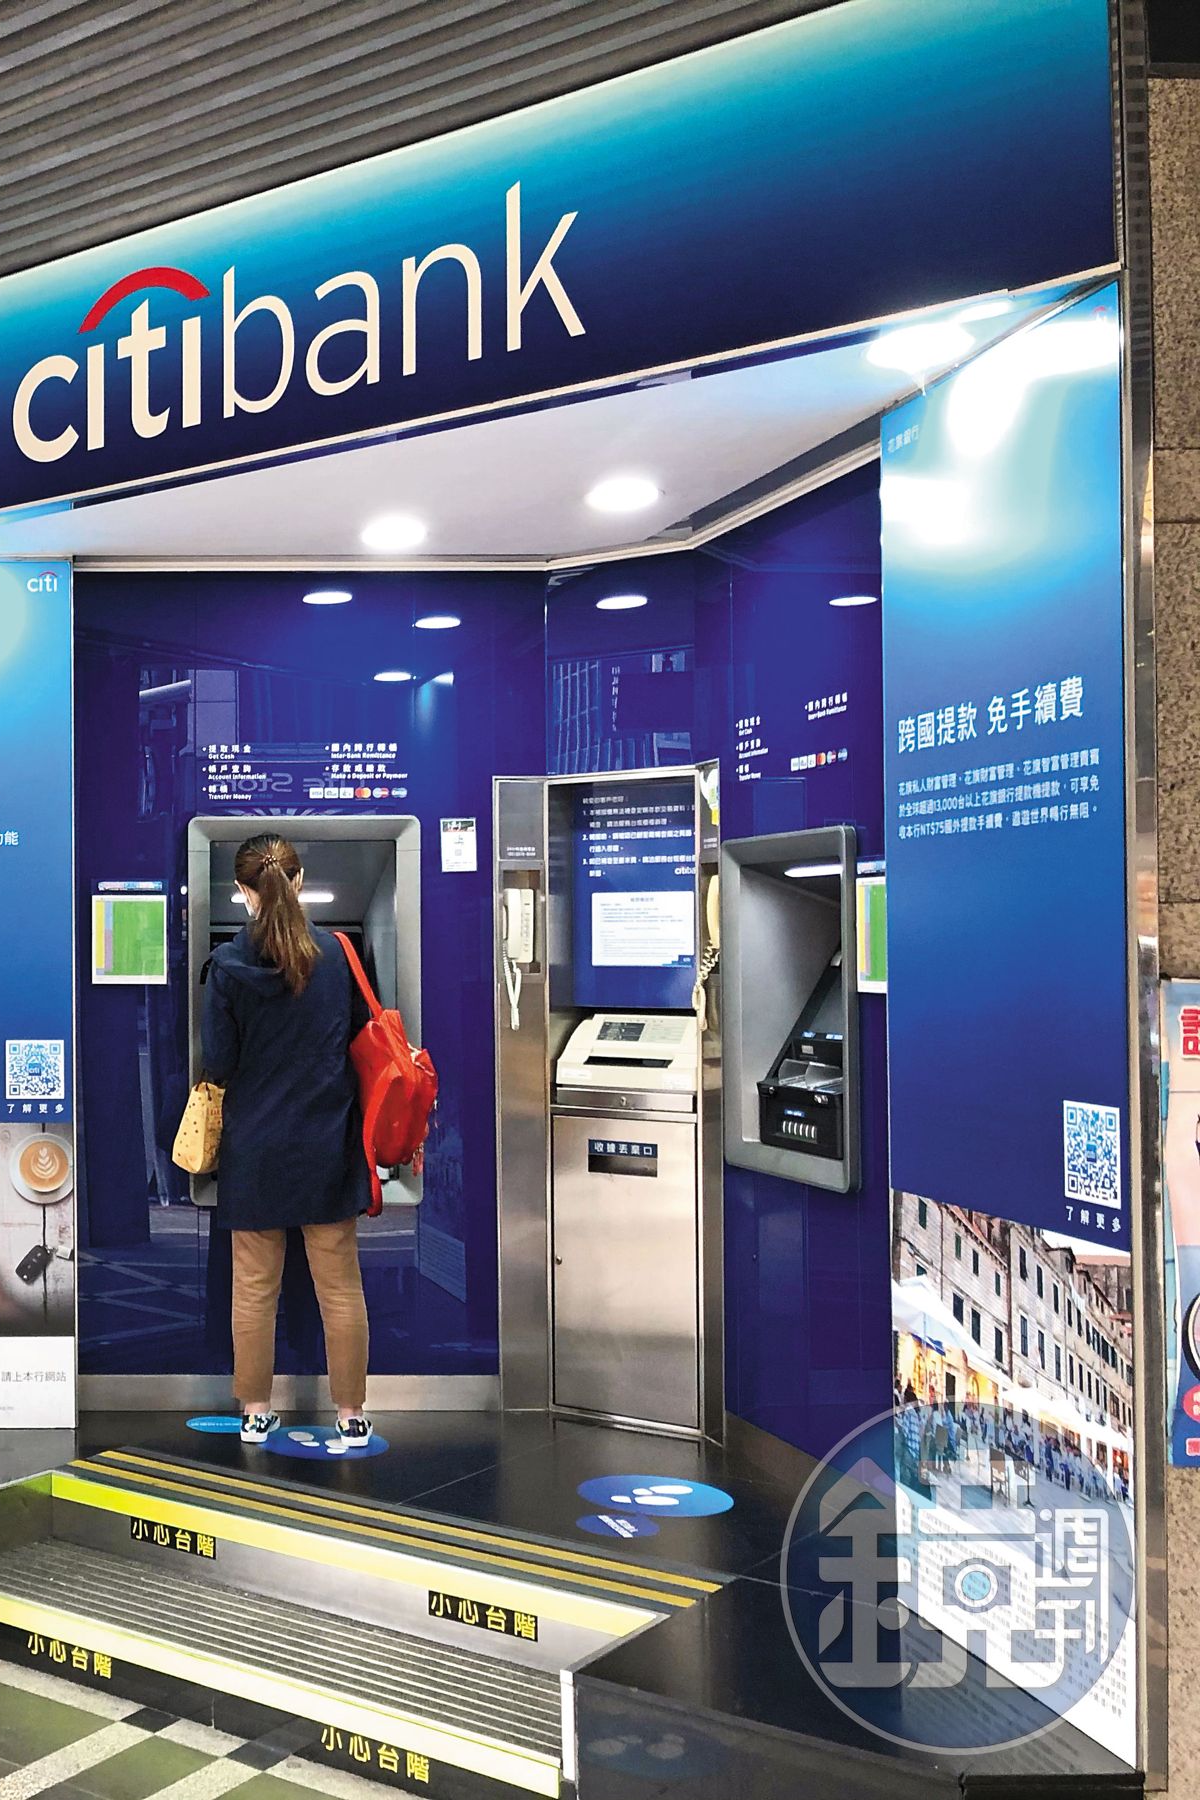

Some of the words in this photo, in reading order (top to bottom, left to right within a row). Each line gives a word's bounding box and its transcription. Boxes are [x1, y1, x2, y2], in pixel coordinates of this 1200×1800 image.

[12, 181, 586, 463] citibank
[27, 570, 58, 592] citi
[898, 703, 977, 754] 跨國提款
[987, 676, 1084, 735] 免手續費
[7, 1103, 64, 1113] 了解更多
[1065, 1205, 1122, 1233] 了解更多
[132, 1519, 214, 1558] 小心台階
[431, 1593, 536, 1640] 小心台階
[27, 1634, 112, 1680] 小心台階
[321, 1726, 429, 1784] 小心台階
